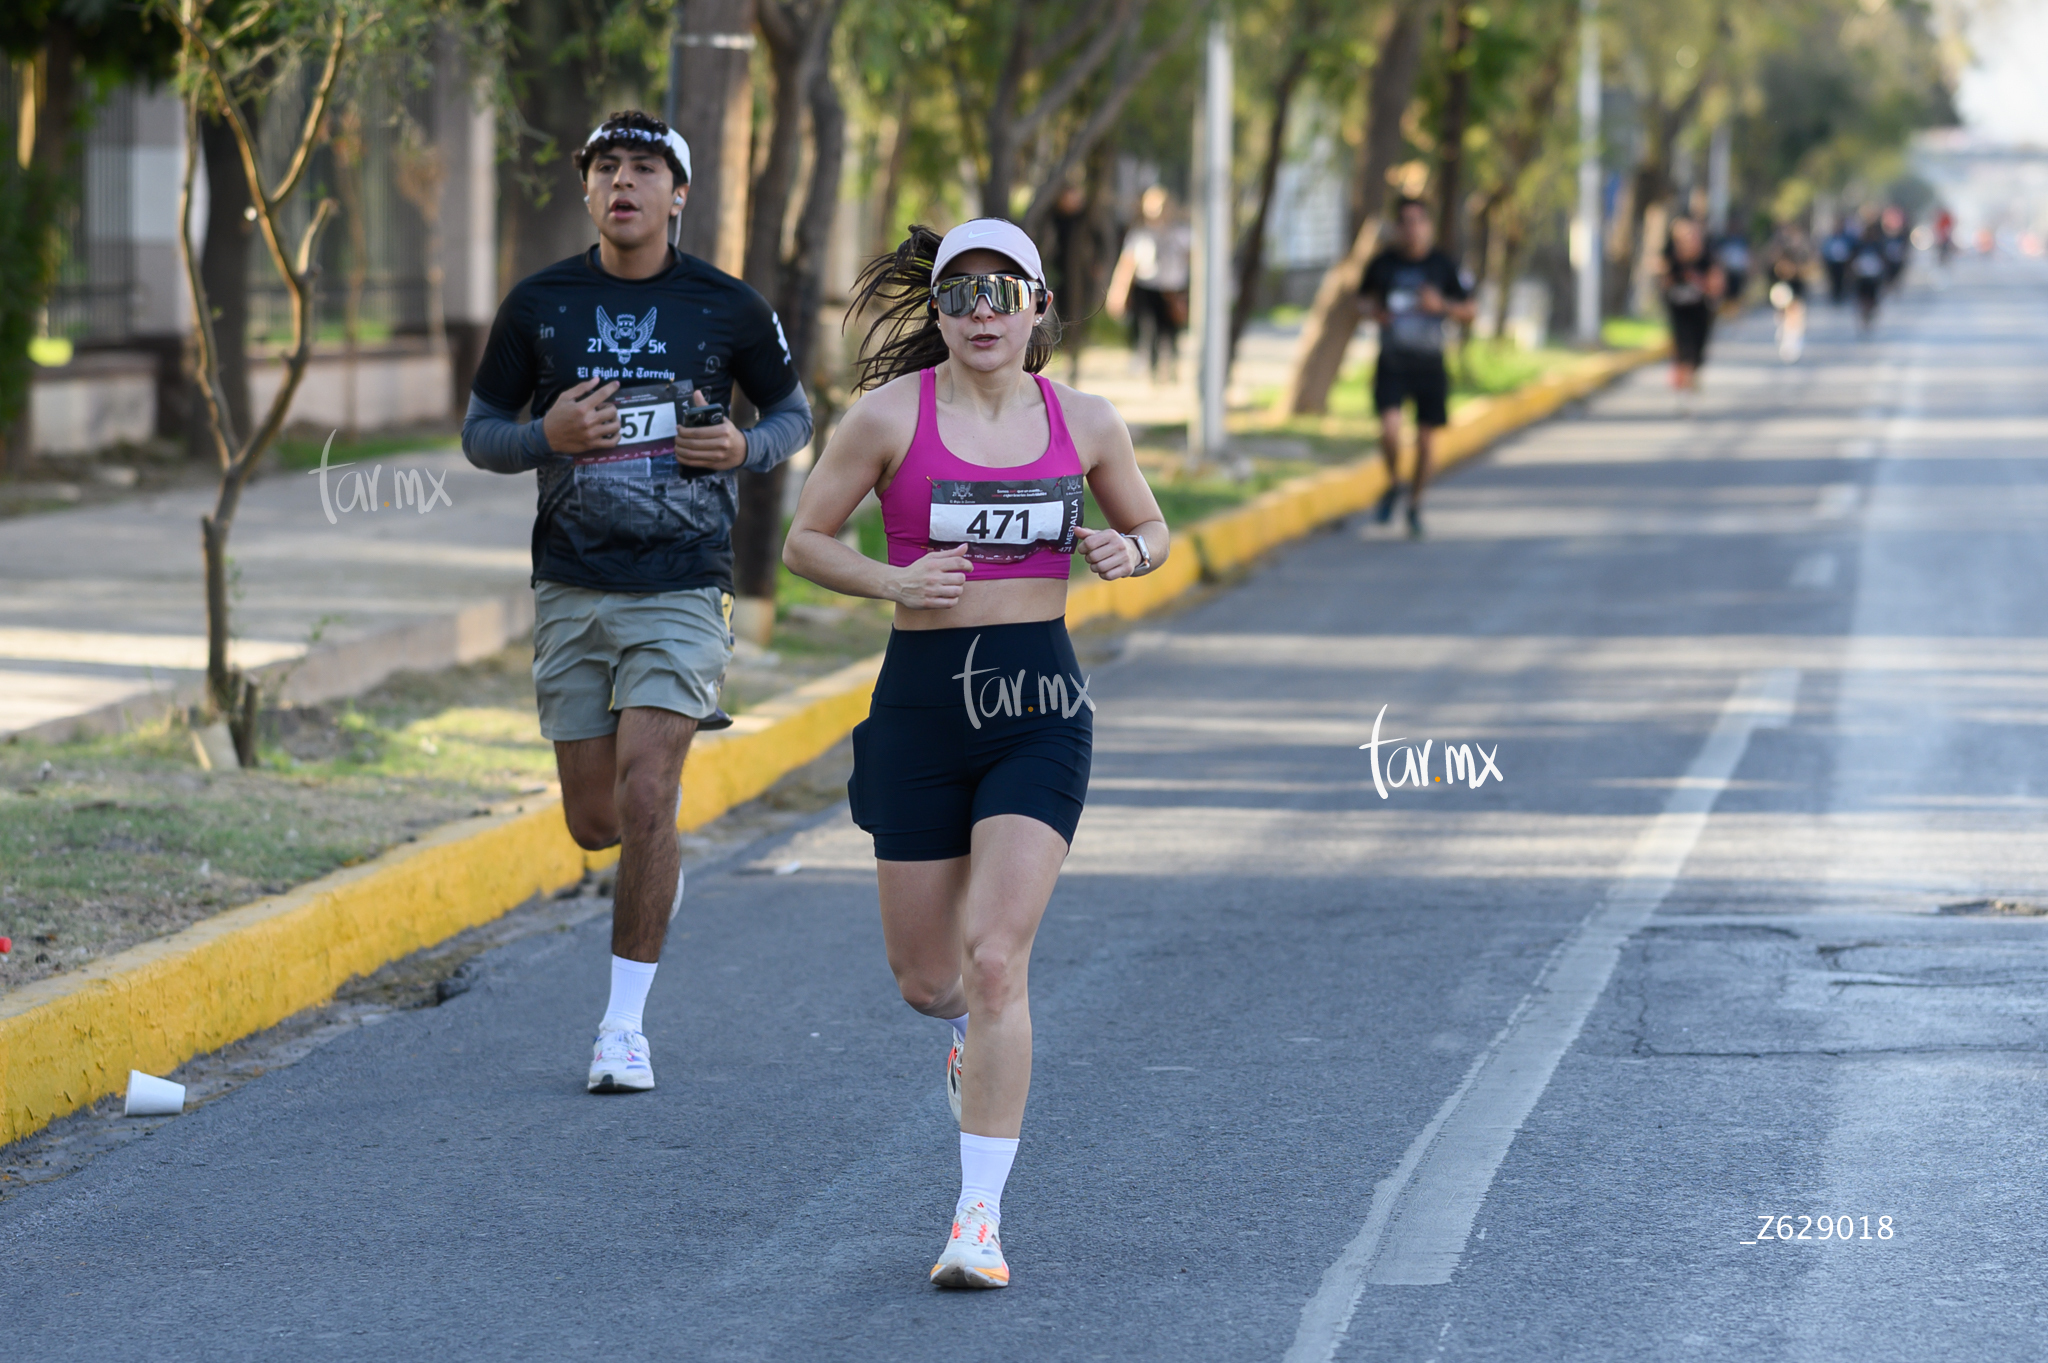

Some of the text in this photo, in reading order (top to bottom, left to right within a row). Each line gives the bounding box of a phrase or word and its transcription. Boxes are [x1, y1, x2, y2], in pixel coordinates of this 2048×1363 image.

[587, 338, 667, 354] 21 5K
[577, 367, 589, 378] El
[592, 366, 620, 379] Siglo
[622, 367, 634, 378] de
[966, 509, 1030, 540] 471
[1064, 498, 1079, 545] MEDALLA
